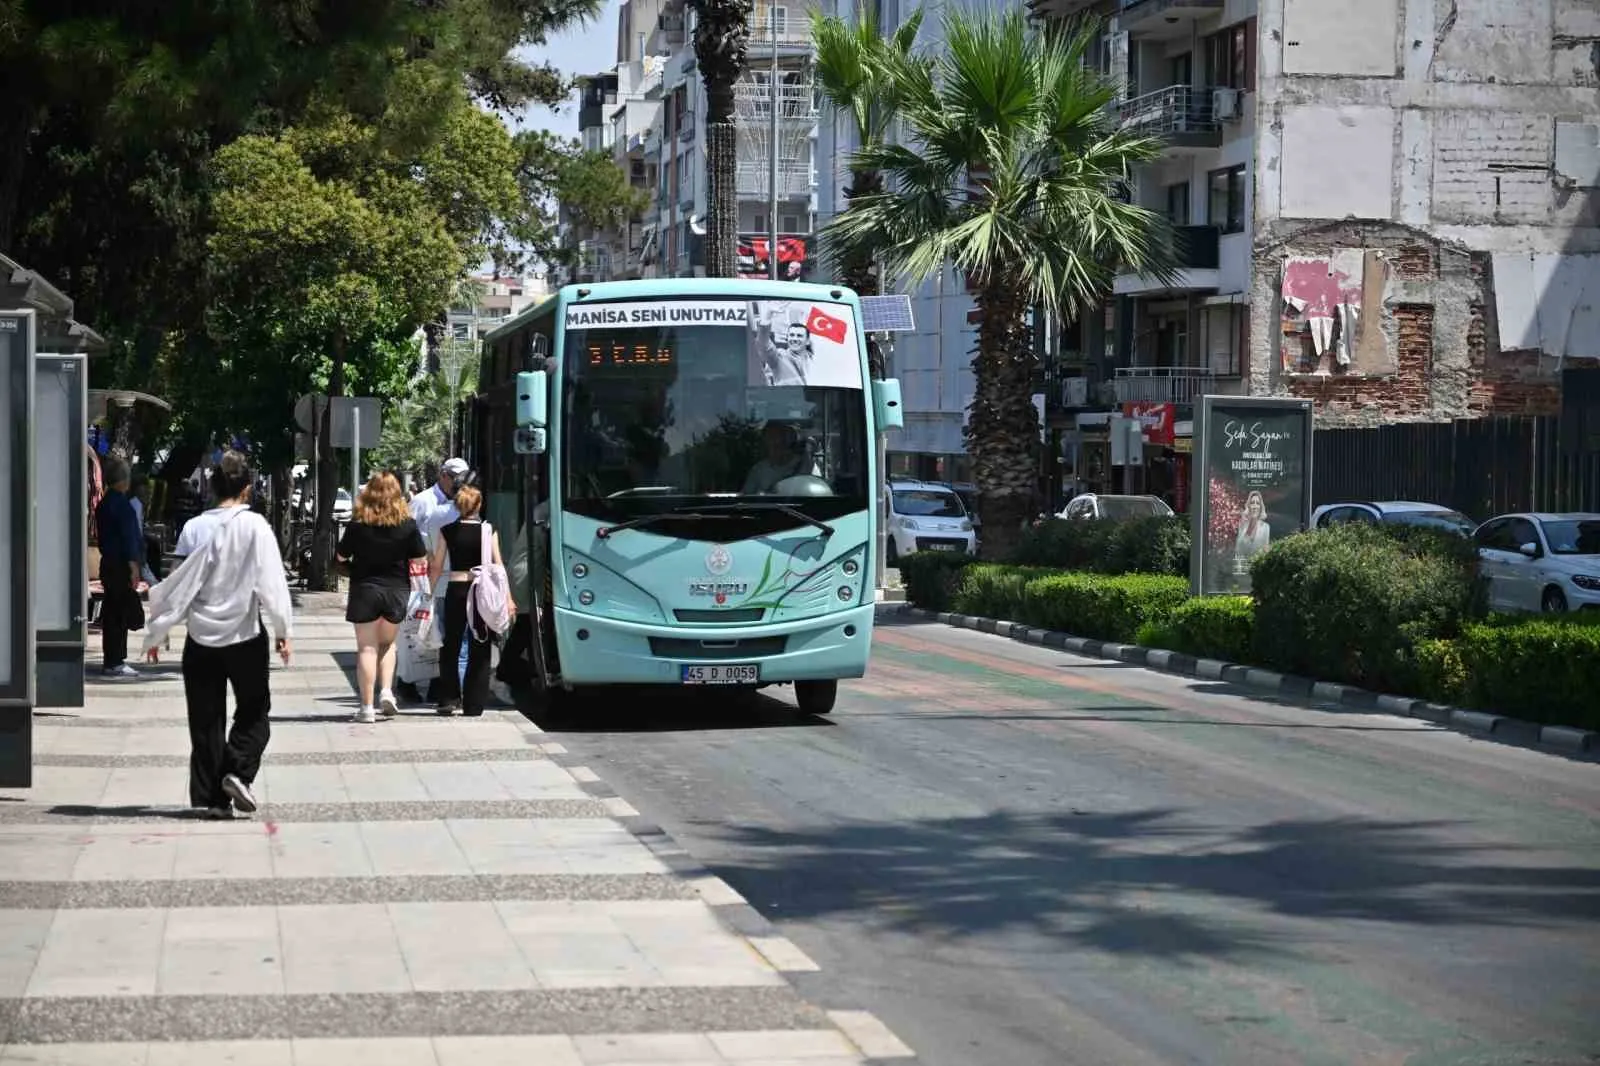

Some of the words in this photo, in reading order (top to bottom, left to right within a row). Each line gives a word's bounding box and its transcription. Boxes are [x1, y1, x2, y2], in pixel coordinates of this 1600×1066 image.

[567, 309, 628, 325] MANİSA
[631, 306, 666, 322] SENİ
[670, 308, 747, 321] UNUTMAZ
[1250, 422, 1282, 454] Sayan
[689, 668, 704, 679] 45
[711, 667, 718, 679] D
[726, 667, 756, 679] 0059
